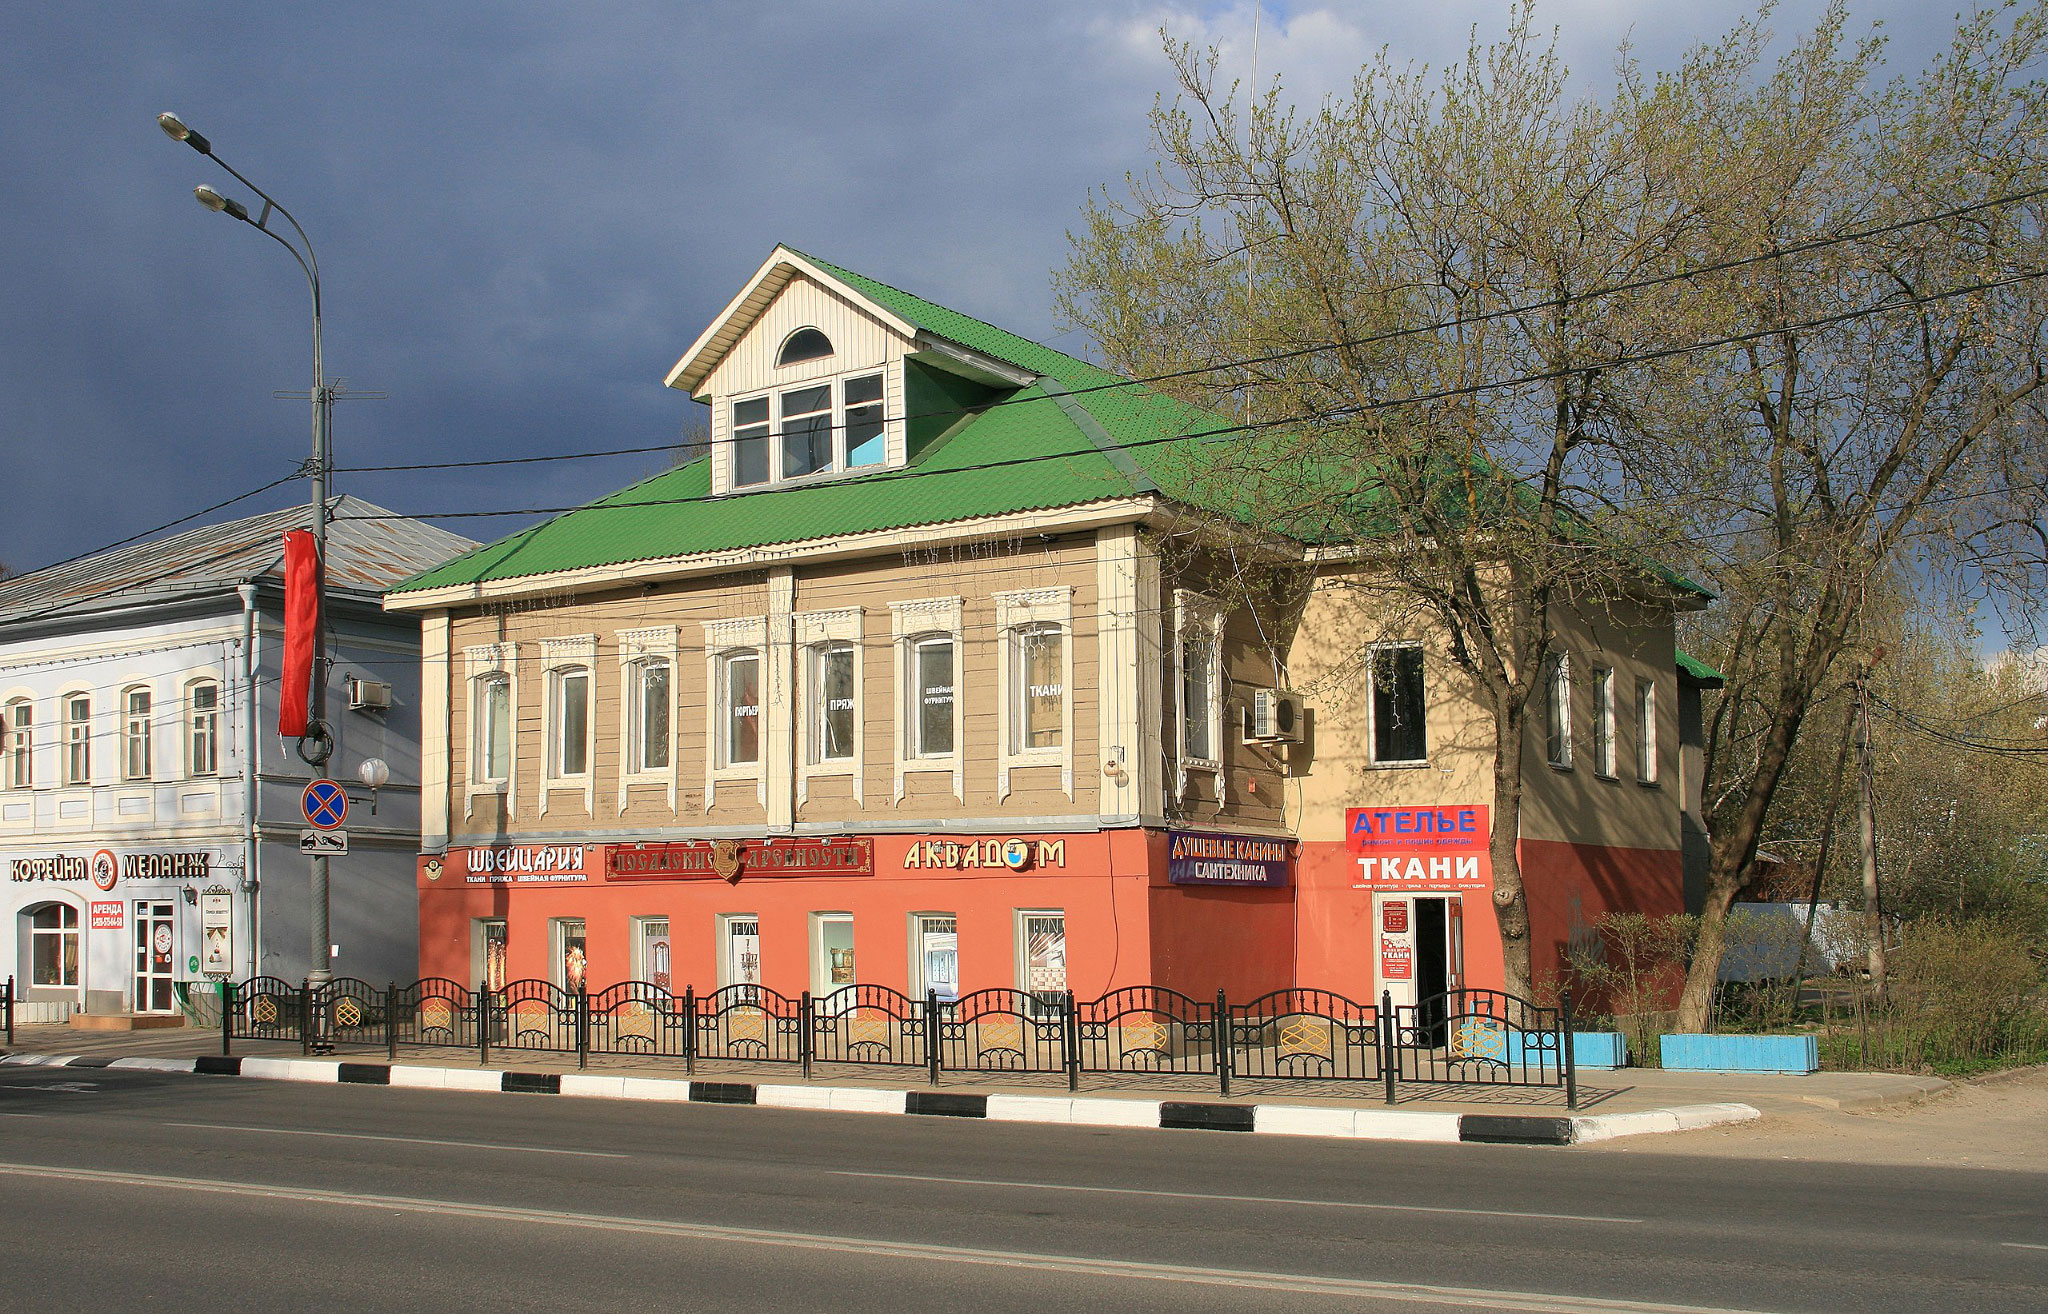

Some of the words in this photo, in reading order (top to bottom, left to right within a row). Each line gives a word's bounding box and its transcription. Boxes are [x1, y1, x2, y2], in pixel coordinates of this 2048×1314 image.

[1030, 684, 1063, 697] ТКАНИ
[1352, 810, 1477, 834] АТЕЛЬЕ
[1172, 836, 1235, 860] ДУШЕВЫЕ
[1236, 841, 1286, 862] КАБИНЫ
[1405, 838, 1434, 846] пошив
[1436, 837, 1473, 845] одежды
[467, 846, 584, 872] ШВЕЙЦАРИЯ
[746, 847, 859, 868] ДРЕВНОСТИ
[903, 838, 1066, 869] АКВАДОМ
[10, 854, 88, 881] КОФЕЙНЯ
[122, 853, 209, 879] МЕЛАНЖ
[517, 874, 549, 882] ШВЕЙНАЯ
[550, 874, 587, 882] ФУРНИТУРА
[1195, 862, 1267, 881] САНТЕХНИКА
[1357, 857, 1479, 880] ТКАНИ
[93, 904, 122, 915] АРЕНДА
